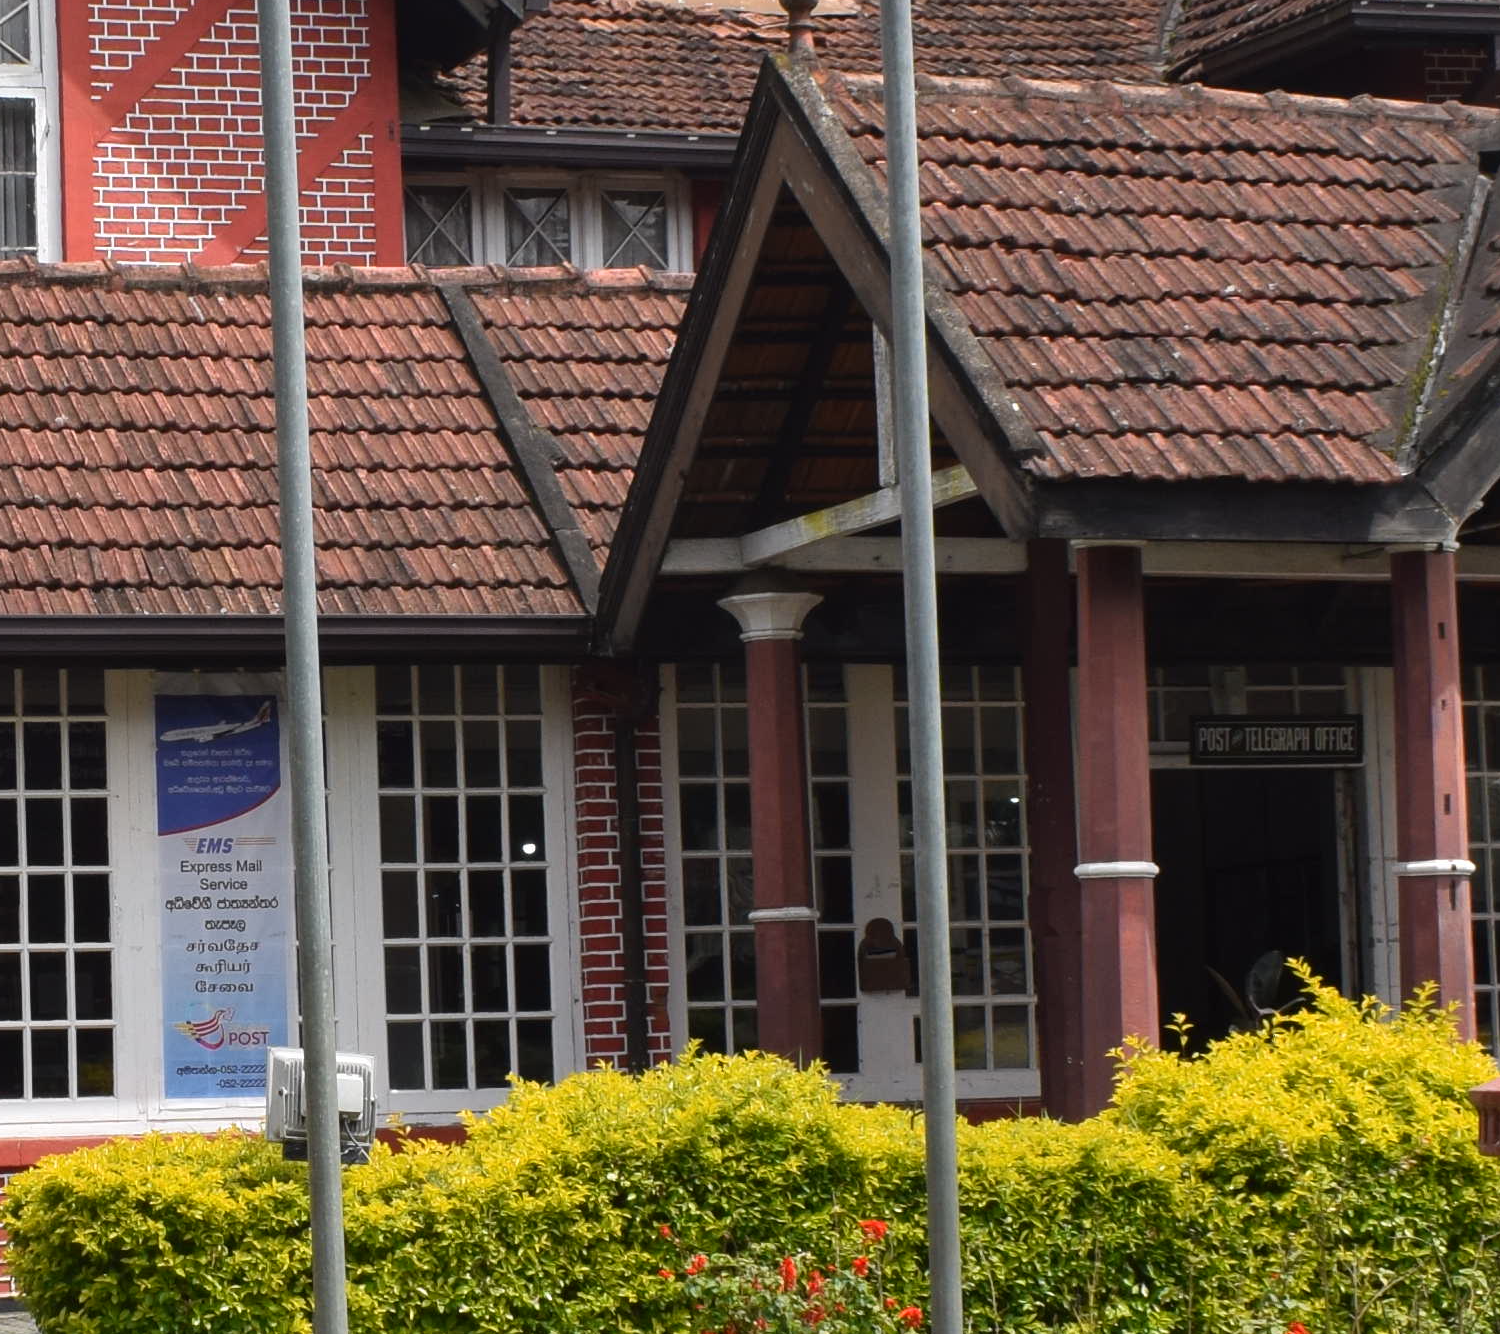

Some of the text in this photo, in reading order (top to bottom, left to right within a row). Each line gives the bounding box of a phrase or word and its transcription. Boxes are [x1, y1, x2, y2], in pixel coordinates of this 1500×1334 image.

[1198, 727, 1232, 752] POST
[1244, 727, 1310, 752] TELEGRAPH
[1314, 726, 1355, 752] OFFICE
[196, 837, 234, 854] EMS
[180, 860, 262, 876] Express Mail
[199, 878, 248, 891] Service
[194, 980, 254, 994] சேவை
[228, 1031, 270, 1046] POST
